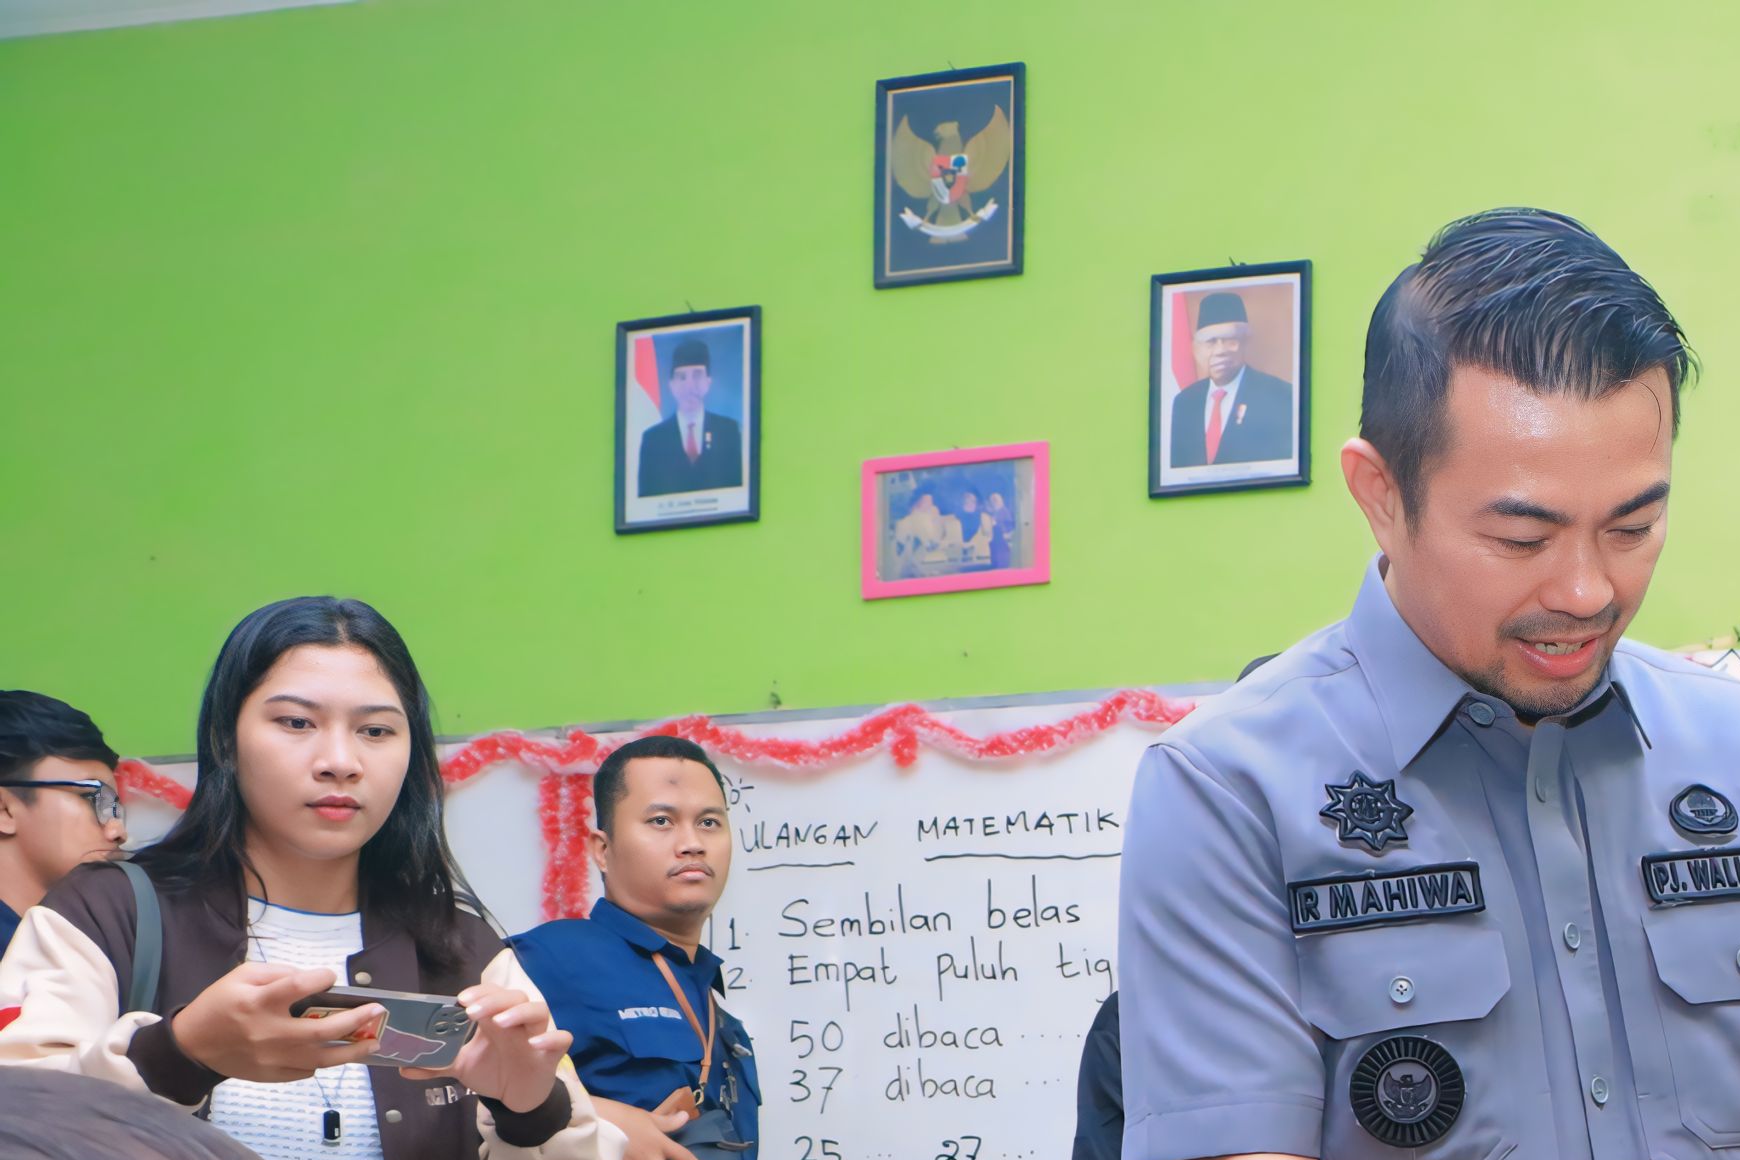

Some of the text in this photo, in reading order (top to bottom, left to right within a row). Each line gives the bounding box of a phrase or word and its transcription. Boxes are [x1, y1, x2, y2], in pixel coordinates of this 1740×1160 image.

[739, 808, 1120, 853] ULANGAN MATEMATIK
[777, 883, 951, 937] Sembilan
[987, 874, 1081, 930] belas
[1329, 871, 1473, 919] MAHIWA
[787, 946, 898, 1012] Empat
[936, 935, 1018, 1001] puluh
[789, 1019, 844, 1059] 50
[788, 1066, 844, 1115] 37
